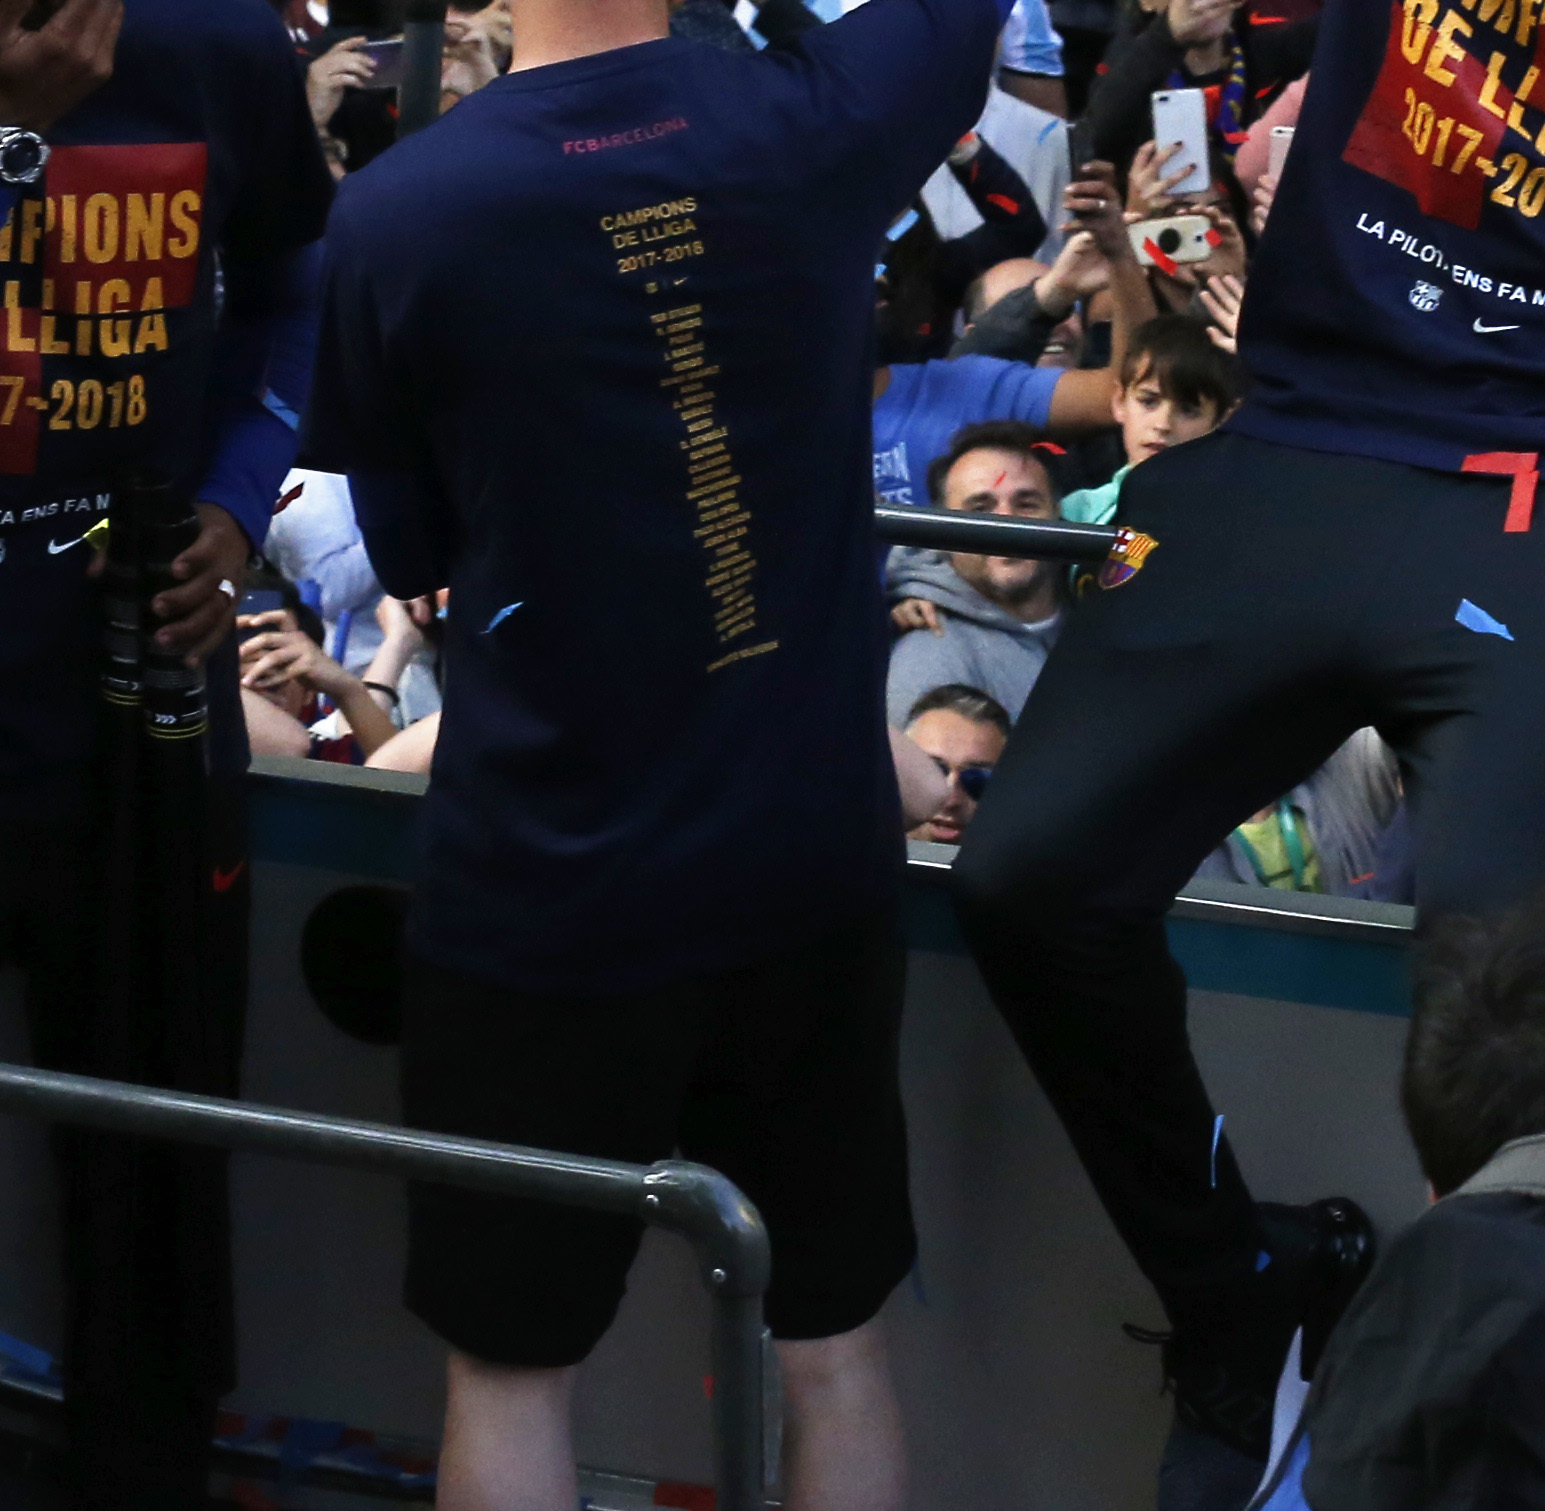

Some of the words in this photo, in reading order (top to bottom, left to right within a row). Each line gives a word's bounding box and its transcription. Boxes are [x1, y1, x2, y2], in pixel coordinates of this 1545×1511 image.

[600, 197, 698, 231] CAMPIONS
[612, 231, 640, 250] DE
[641, 218, 697, 242] LLIGA
[1356, 213, 1385, 239] LA
[1452, 265, 1493, 293] ENS
[1497, 283, 1527, 303] FA
[4, 276, 170, 357] LLIGA
[21, 502, 60, 522] ENS
[63, 498, 92, 513] FA
